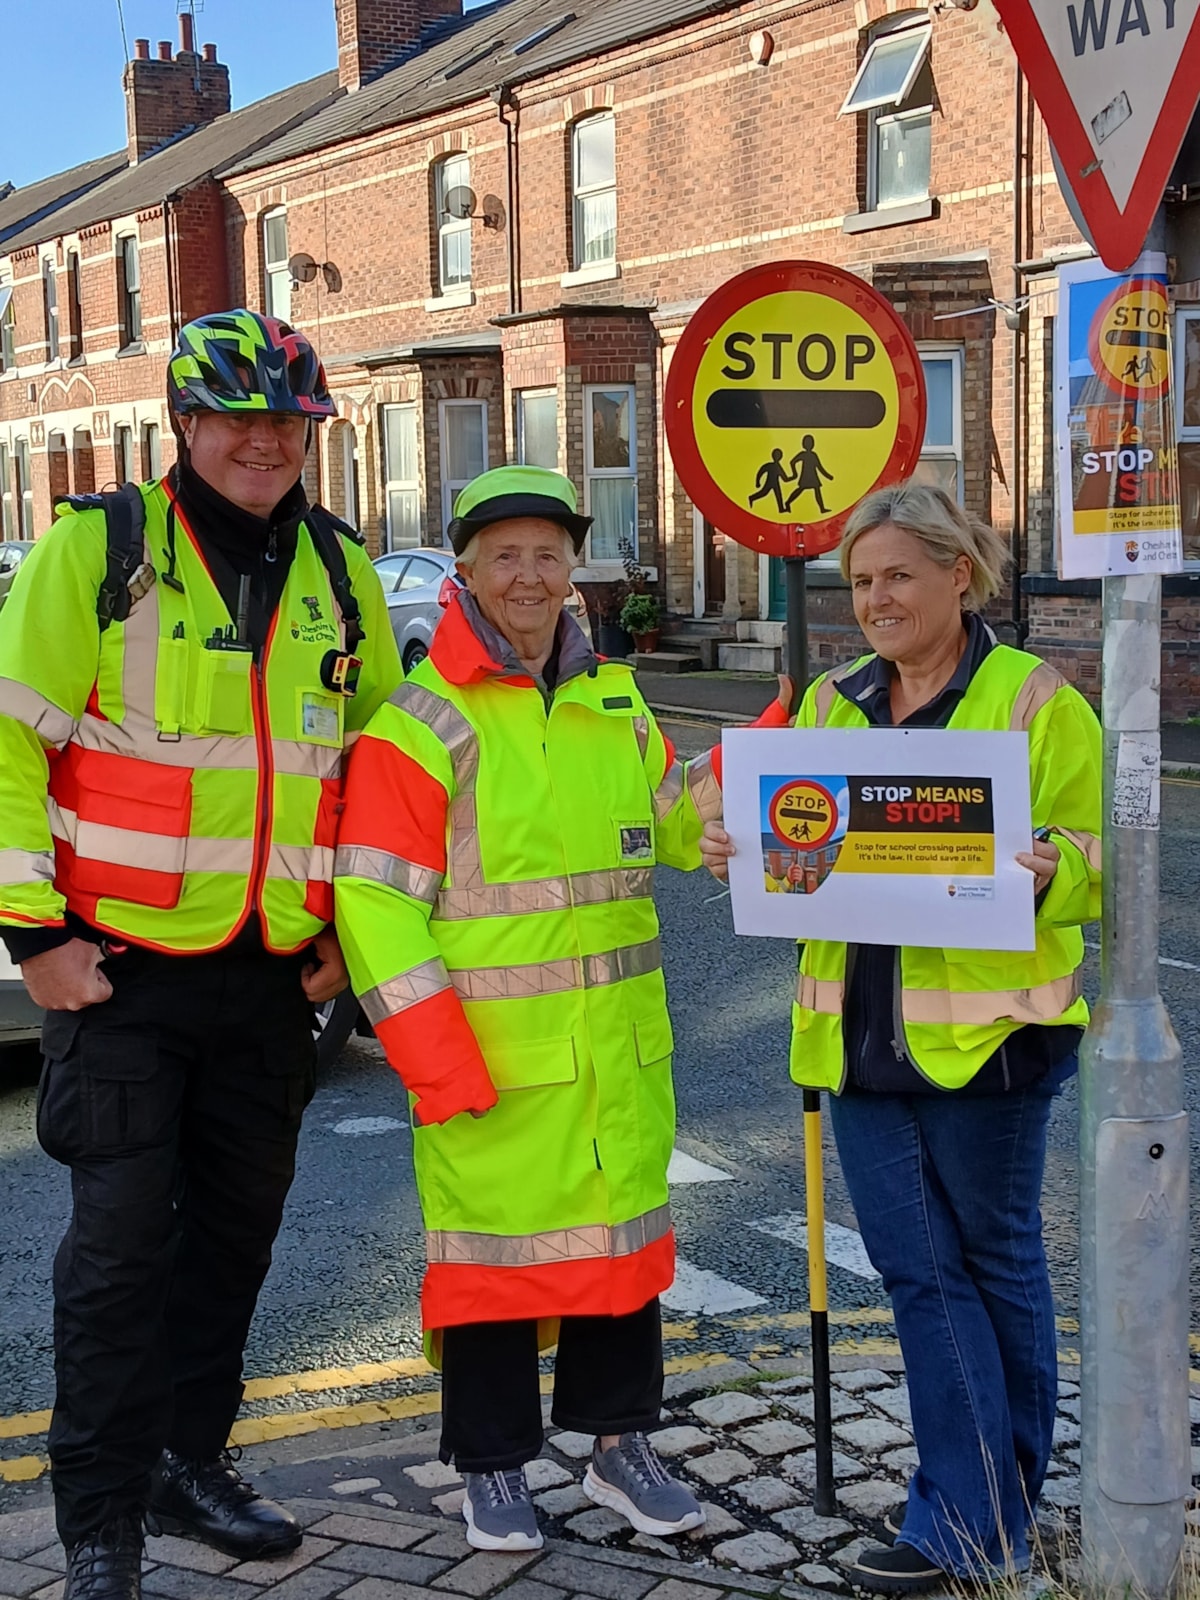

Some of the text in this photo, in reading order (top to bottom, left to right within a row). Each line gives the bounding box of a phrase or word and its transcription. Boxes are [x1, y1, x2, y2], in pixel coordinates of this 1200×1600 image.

[721, 332, 876, 381] STOP
[1082, 448, 1154, 474] STOP
[1127, 520, 1140, 528] the
[784, 794, 826, 810] STOP
[861, 786, 985, 803] STOP MEANS
[886, 802, 960, 823] STOP!
[854, 843, 874, 852] Stop
[875, 843, 887, 851] for
[889, 843, 916, 851] school
[918, 843, 954, 853] crossing
[858, 853, 872, 861] It's
[873, 853, 887, 861] the
[906, 853, 913, 861] It
[915, 853, 938, 861] could
[940, 854, 959, 862] save
